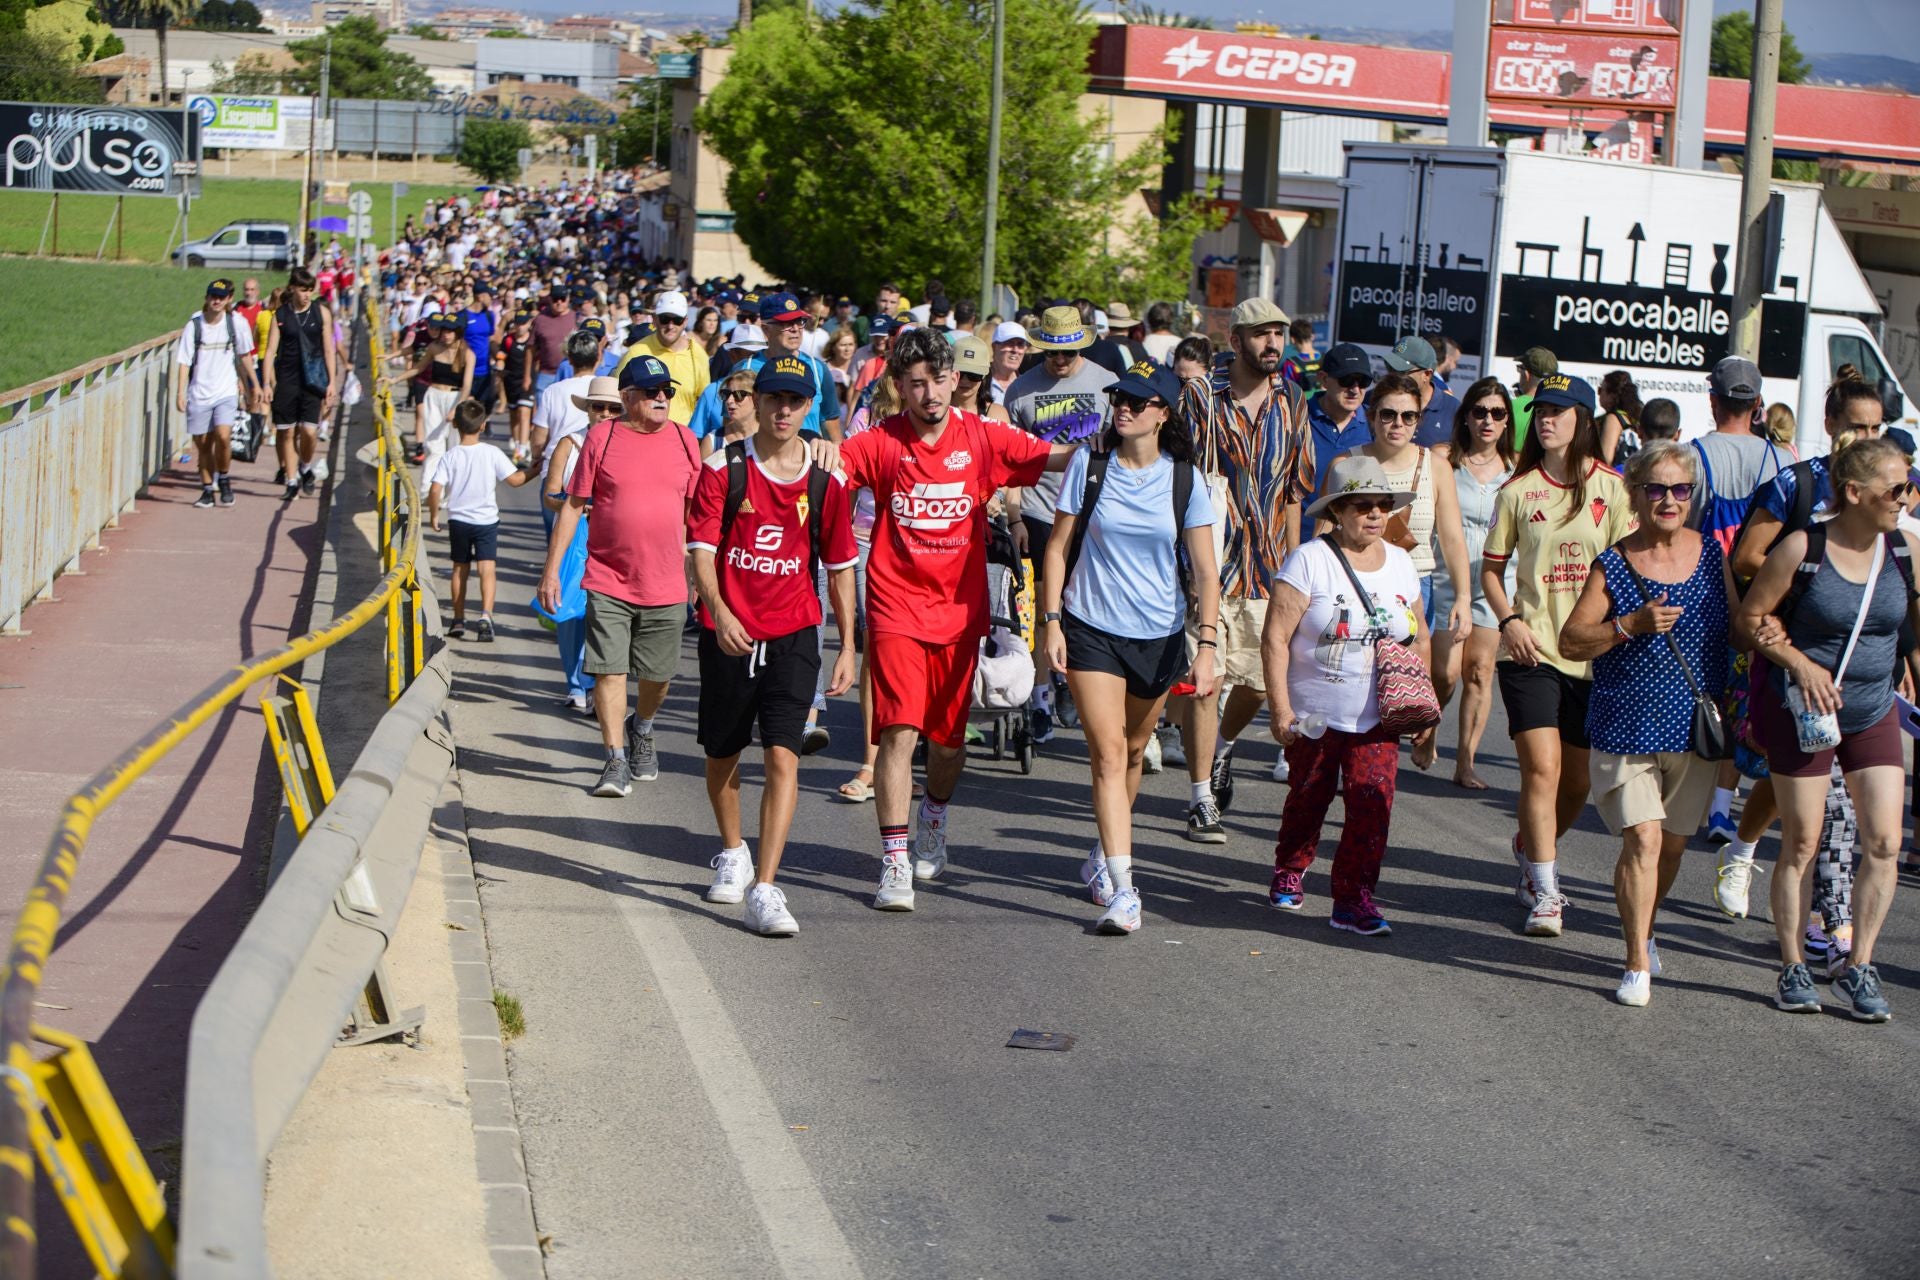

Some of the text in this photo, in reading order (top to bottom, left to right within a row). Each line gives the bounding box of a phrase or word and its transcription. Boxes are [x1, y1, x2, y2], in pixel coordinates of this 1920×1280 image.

[1215, 44, 1358, 88] CEPSA
[28, 112, 149, 132] GIMNASIO
[1553, 294, 1730, 336] pacocaballe
[776, 357, 805, 371] UCAM
[1602, 333, 1706, 367] muebles
[1543, 375, 1571, 386] UCAM
[1036, 397, 1077, 426] NIKE
[1067, 412, 1101, 442] AIR
[1525, 490, 1550, 500] ENAE
[727, 546, 802, 576] fibranet
[1553, 563, 1588, 573] NUEVA
